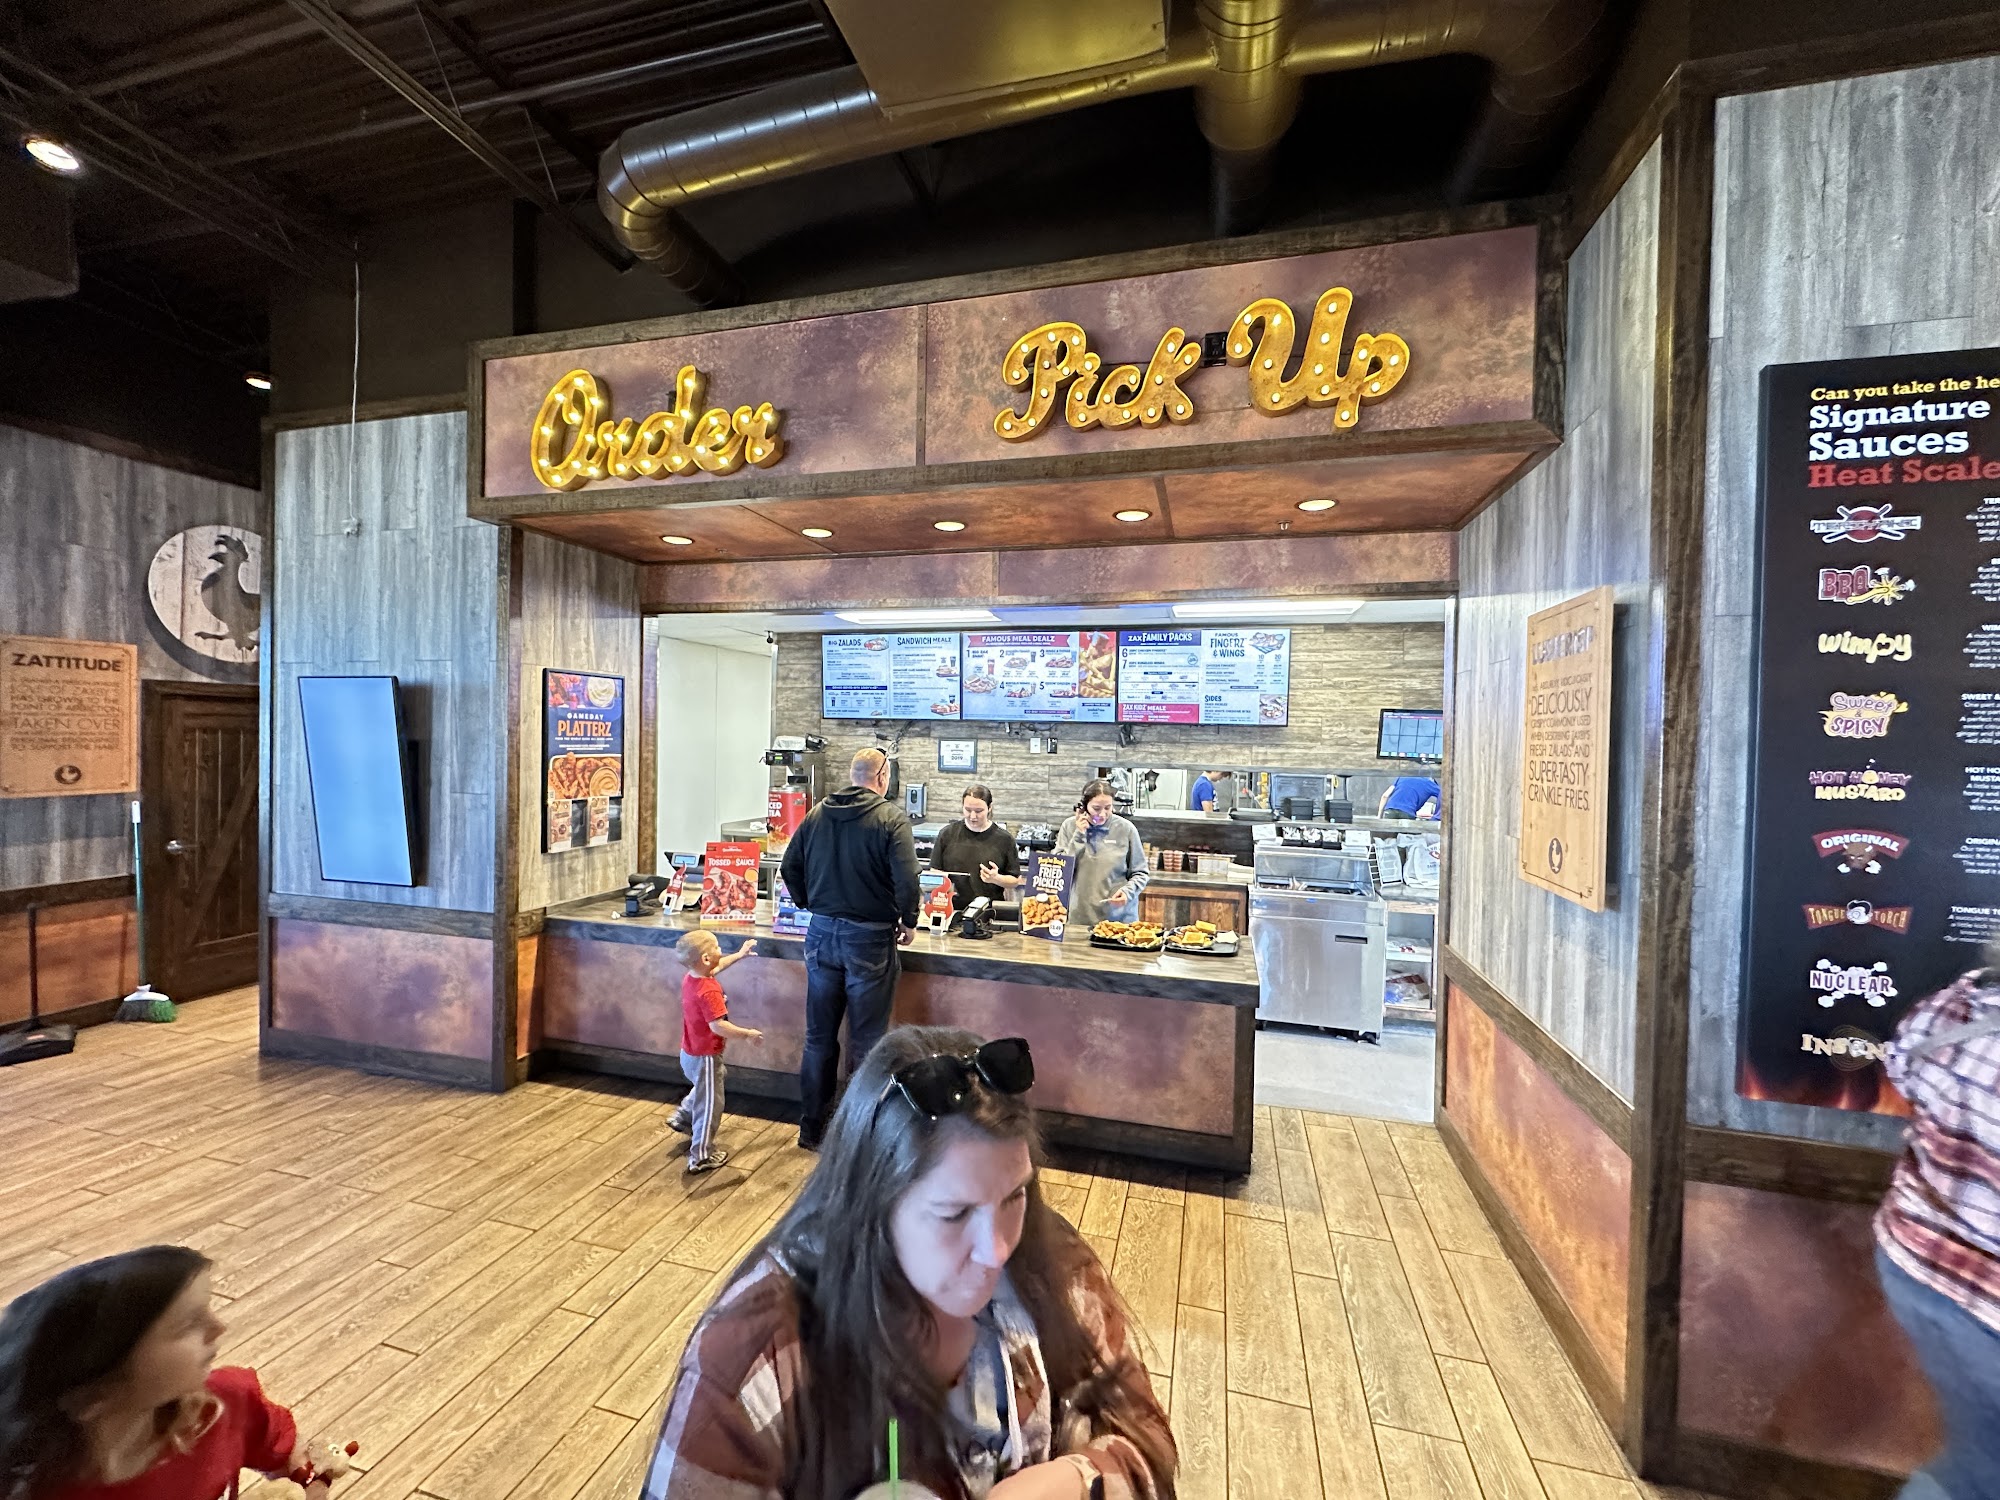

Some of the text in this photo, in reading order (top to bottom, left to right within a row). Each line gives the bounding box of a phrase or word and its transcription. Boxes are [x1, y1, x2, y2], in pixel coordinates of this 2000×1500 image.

[994, 286, 1411, 443] Pick Up
[1810, 387, 1849, 401] Can
[1853, 386, 1888, 401] you
[1893, 381, 1935, 395] take
[1939, 378, 1971, 392] the
[1809, 399, 1991, 433] Signature
[531, 365, 785, 491] Order
[1809, 431, 1969, 462] Sauces
[1807, 456, 2000, 488] Heat Scale
[1822, 568, 1869, 599] BBQ
[838, 638, 861, 647] ZALADS
[897, 637, 932, 645] SANDWICH
[1142, 633, 1168, 642] FAMILY
[1168, 633, 1193, 642] PACKS
[1210, 638, 1245, 648] FINGERZ
[1000, 650, 1005, 658] 2
[1040, 649, 1045, 658] 3
[1122, 648, 1128, 657] 6
[1213, 649, 1245, 658] & WINGS
[11, 653, 122, 672] ZATTITUDE
[1122, 660, 1127, 669] 7
[1039, 682, 1045, 690] 5
[1530, 687, 1592, 716] DELICIOUSLY
[1831, 693, 1896, 712] Sweet
[1961, 693, 1993, 701] SWEET
[567, 712, 604, 720] GAMEDAY
[1577, 715, 1591, 726] USED
[14, 718, 120, 730] TAKEN OVER
[558, 720, 612, 737] PLATTERZ
[1831, 717, 1885, 735] SPICY
[1530, 744, 1590, 758] FRESH ZALADS AND
[1529, 760, 1589, 786] SUPER-TASTY
[1809, 770, 1912, 786] HOT HONEY
[1528, 784, 1590, 811] CRINKLE FRIES.
[1815, 785, 1906, 802] MUSTARD
[1821, 833, 1900, 852] ORIGINAL
[708, 857, 755, 866] TOSSED SAUCE
[1039, 867, 1063, 878] FRIED
[1033, 876, 1065, 891] PICKLES
[1808, 907, 1908, 928] TONGUE TORCH
[1951, 906, 1990, 914] TONGUE
[1812, 972, 1892, 992] NUCLEAR
